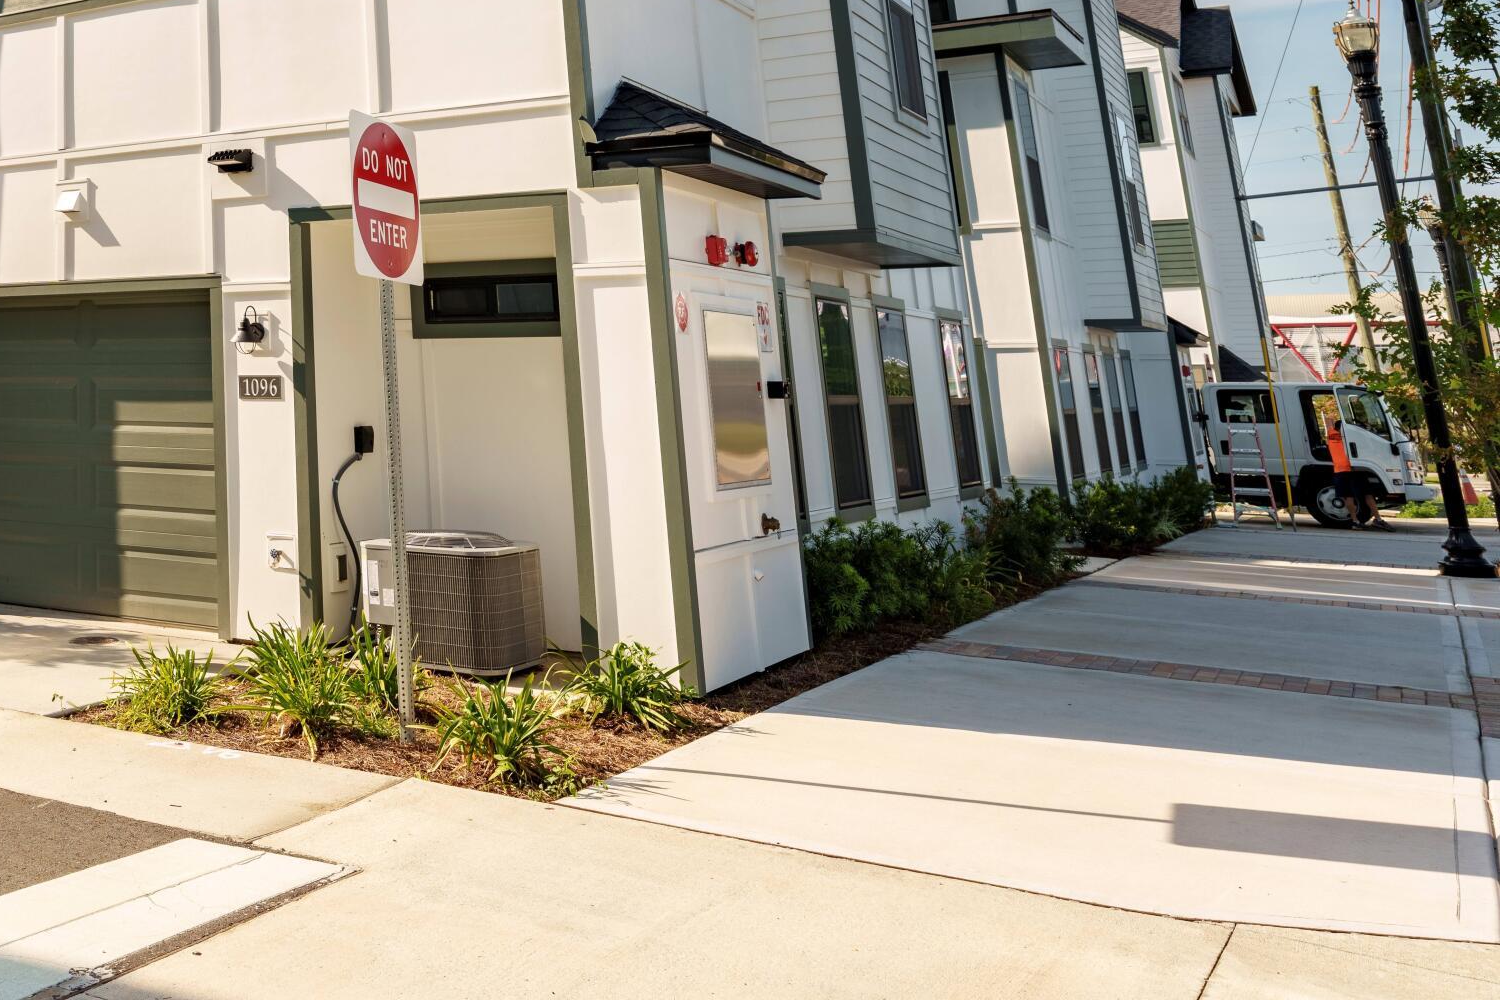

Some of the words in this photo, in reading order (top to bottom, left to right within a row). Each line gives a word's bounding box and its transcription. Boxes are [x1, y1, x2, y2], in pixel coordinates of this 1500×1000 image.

[361, 147, 379, 174] DO
[385, 154, 408, 183] NOT
[369, 219, 408, 250] ENTER
[242, 378, 278, 397] 1096
